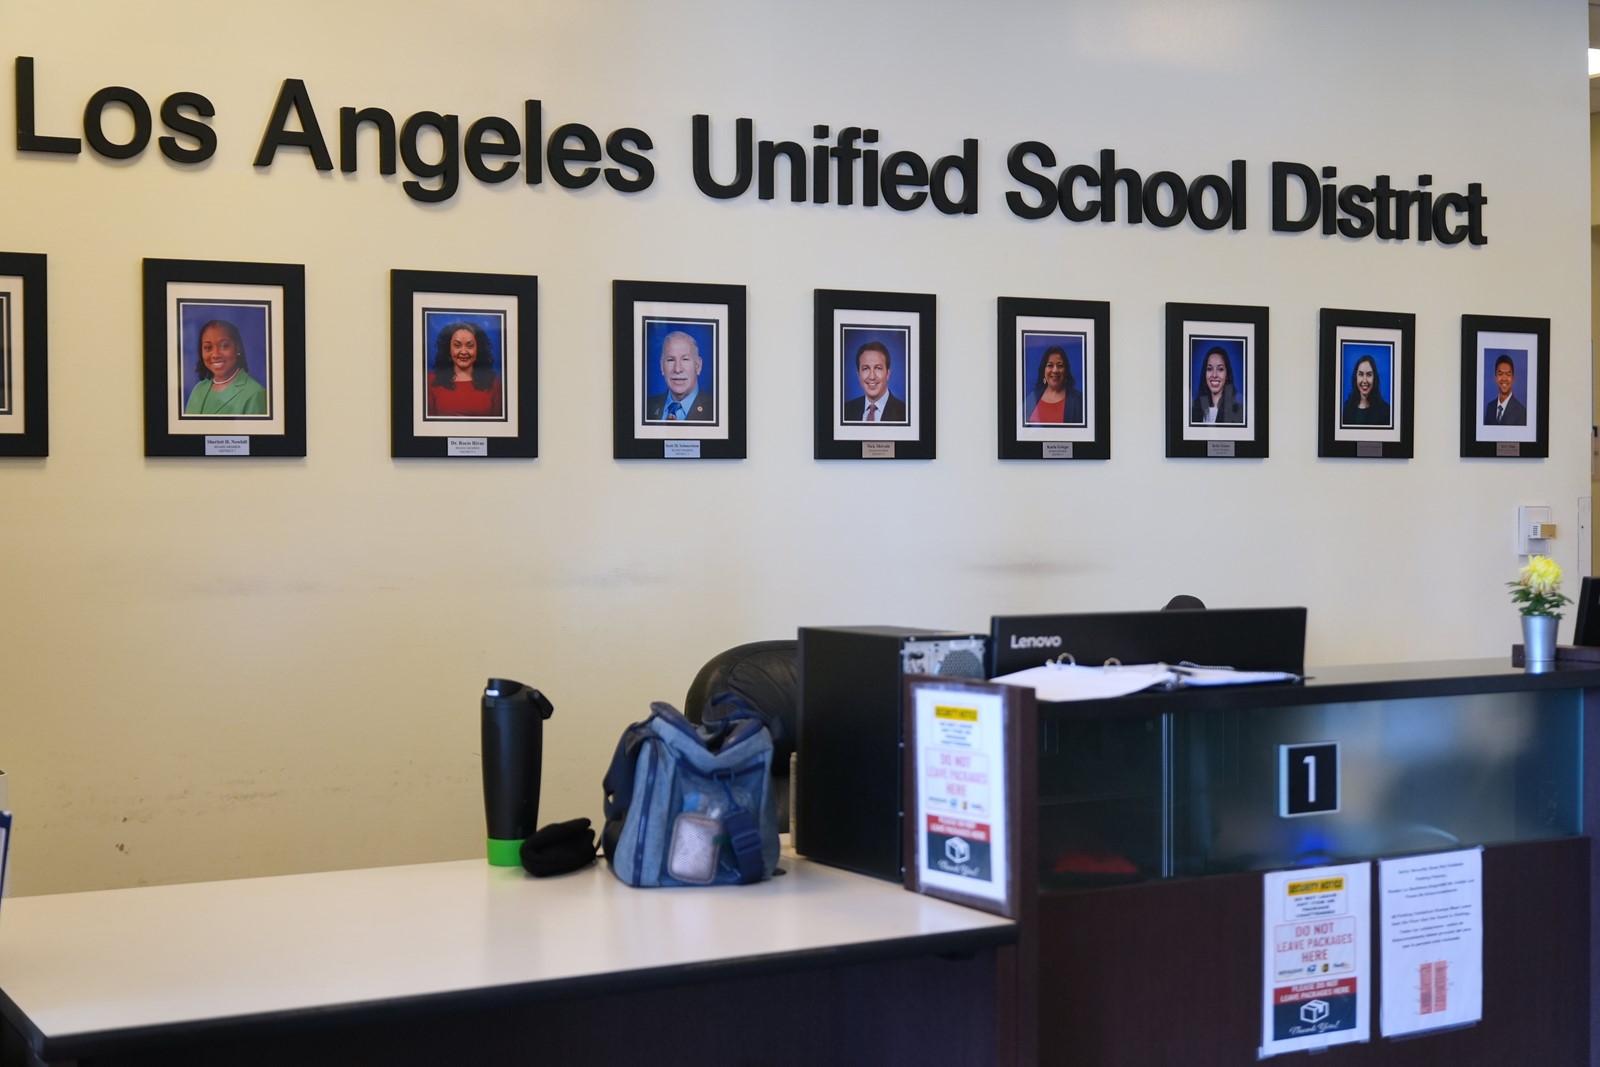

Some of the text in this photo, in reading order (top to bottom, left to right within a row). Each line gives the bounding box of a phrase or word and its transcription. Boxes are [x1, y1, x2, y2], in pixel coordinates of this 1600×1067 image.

[16, 57, 1487, 245] Los Angeles Unified School District
[1010, 634, 1062, 649] Lenovo
[1303, 755, 1316, 803] 1
[1288, 880, 1343, 894] SECURITY NOTICE
[1295, 922, 1334, 938] DO NOT
[1276, 934, 1352, 953] LEAVE PACKAGES
[1301, 949, 1328, 963] HERE
[1280, 985, 1350, 1003] LEAVE PACKAGES HERE
[1291, 983, 1315, 992] PLEASE
[1315, 982, 1325, 990] DO
[1289, 1019, 1341, 1036] Thank You!
